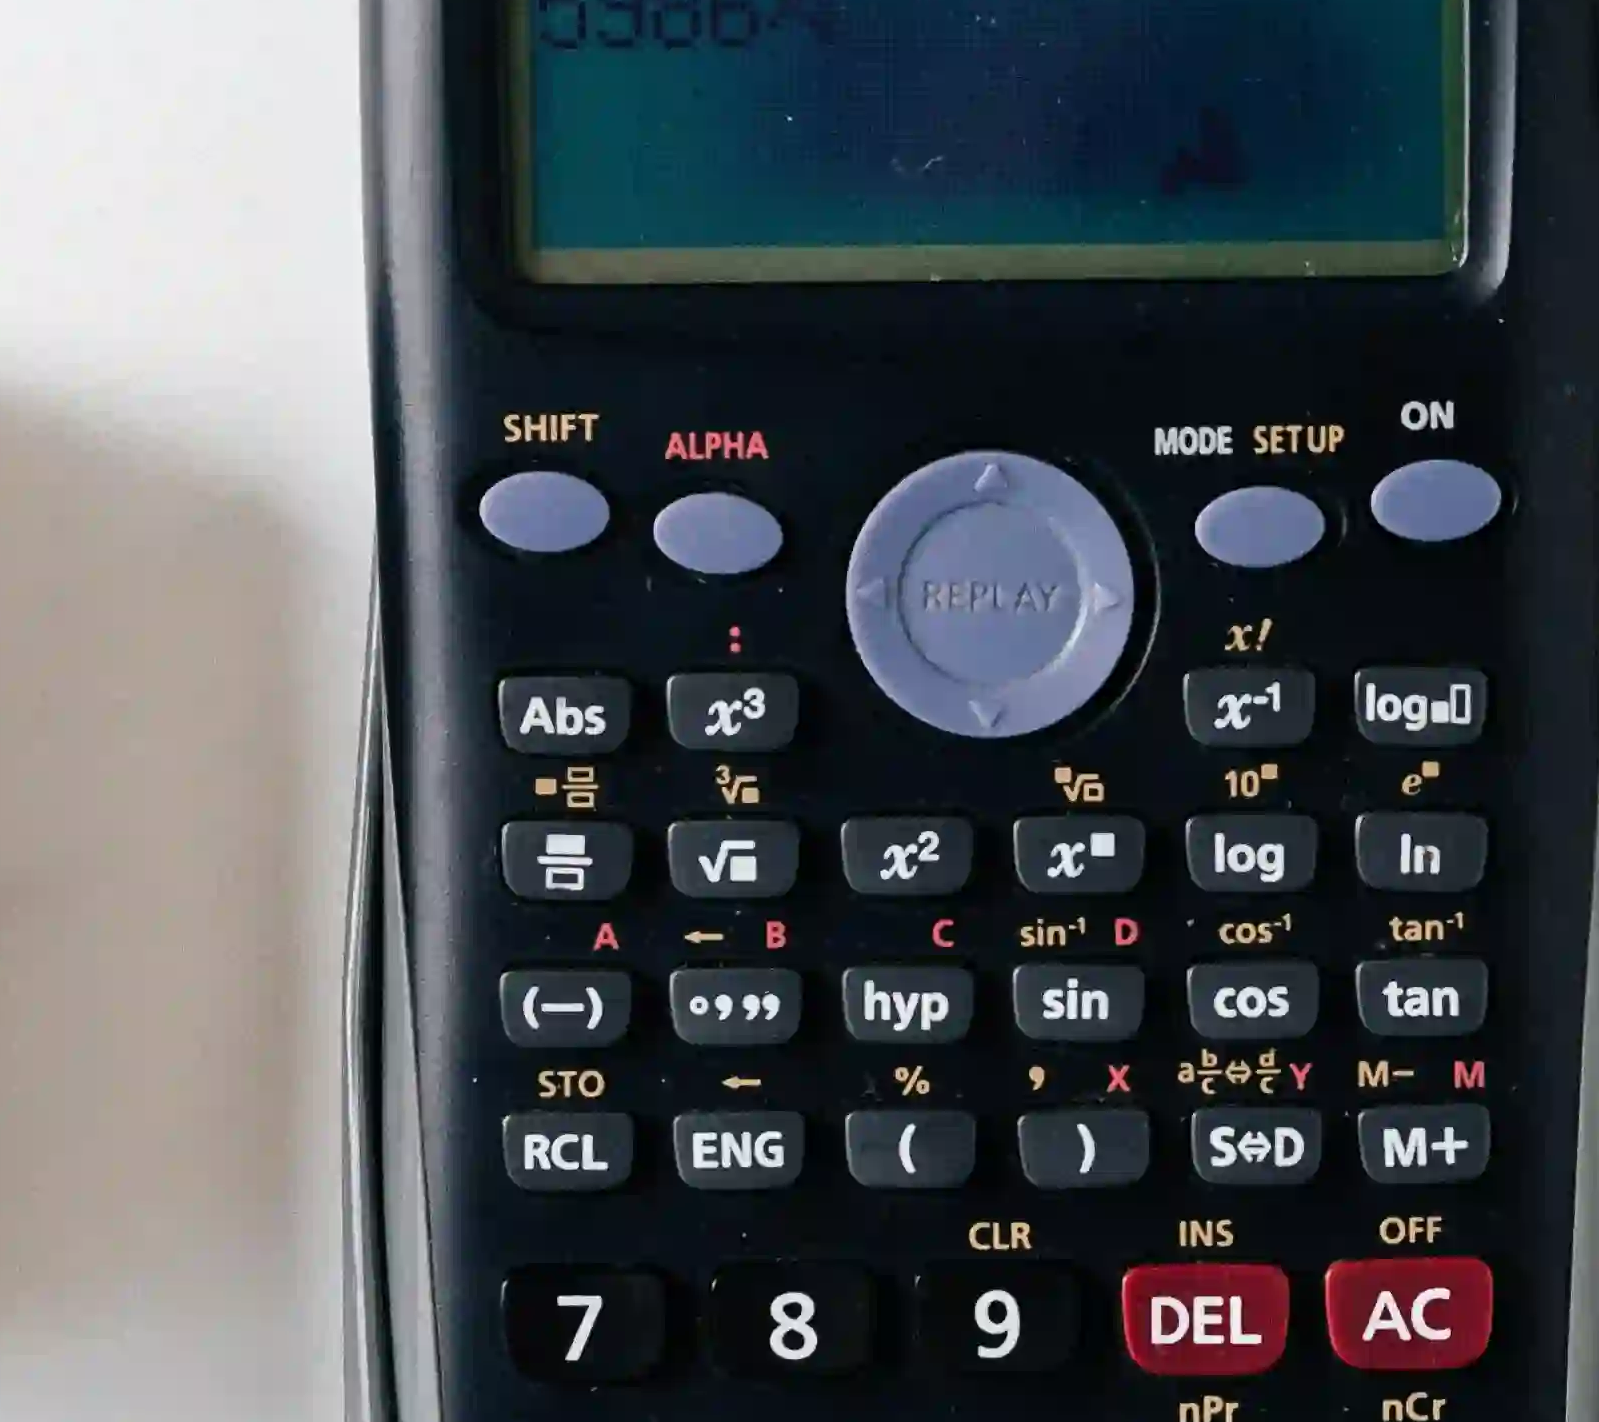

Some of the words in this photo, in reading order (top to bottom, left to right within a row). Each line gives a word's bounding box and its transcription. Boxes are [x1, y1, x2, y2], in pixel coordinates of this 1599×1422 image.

[504, 414, 599, 442] SHIFT
[1401, 401, 1454, 430] ON
[665, 431, 768, 459] ALPHA
[1155, 426, 1233, 455] MODE
[1254, 425, 1344, 454] SETUP
[922, 580, 1059, 613] REPLAY
[1225, 619, 1271, 651] x!
[520, 697, 606, 735] Abs
[1215, 833, 1284, 882] log
[1400, 833, 1440, 874] ln
[594, 923, 618, 950] A
[767, 921, 786, 948] B
[933, 920, 953, 947] C
[1115, 918, 1138, 945] D
[864, 980, 949, 1031] hyp
[1042, 978, 1109, 1019] sin
[1214, 986, 1289, 1018] cos
[1382, 981, 1459, 1017] tan
[539, 1071, 604, 1097] STO
[895, 1066, 929, 1095] %
[1108, 1066, 1129, 1092] X
[1290, 1063, 1311, 1089] Y
[1454, 1061, 1484, 1088] M
[524, 1134, 608, 1170] RCL
[693, 1131, 784, 1169] ENG
[1383, 1127, 1468, 1167] M+
[969, 1222, 1031, 1250] CLR
[1180, 1220, 1233, 1247] INS
[1380, 1217, 1441, 1243] OFF
[557, 1295, 602, 1360] 7
[770, 1292, 817, 1360] 8
[975, 1290, 1020, 1358] 9
[1152, 1296, 1261, 1344] DEL
[1363, 1288, 1451, 1341] AC
[1383, 1392, 1445, 1421] nCr
